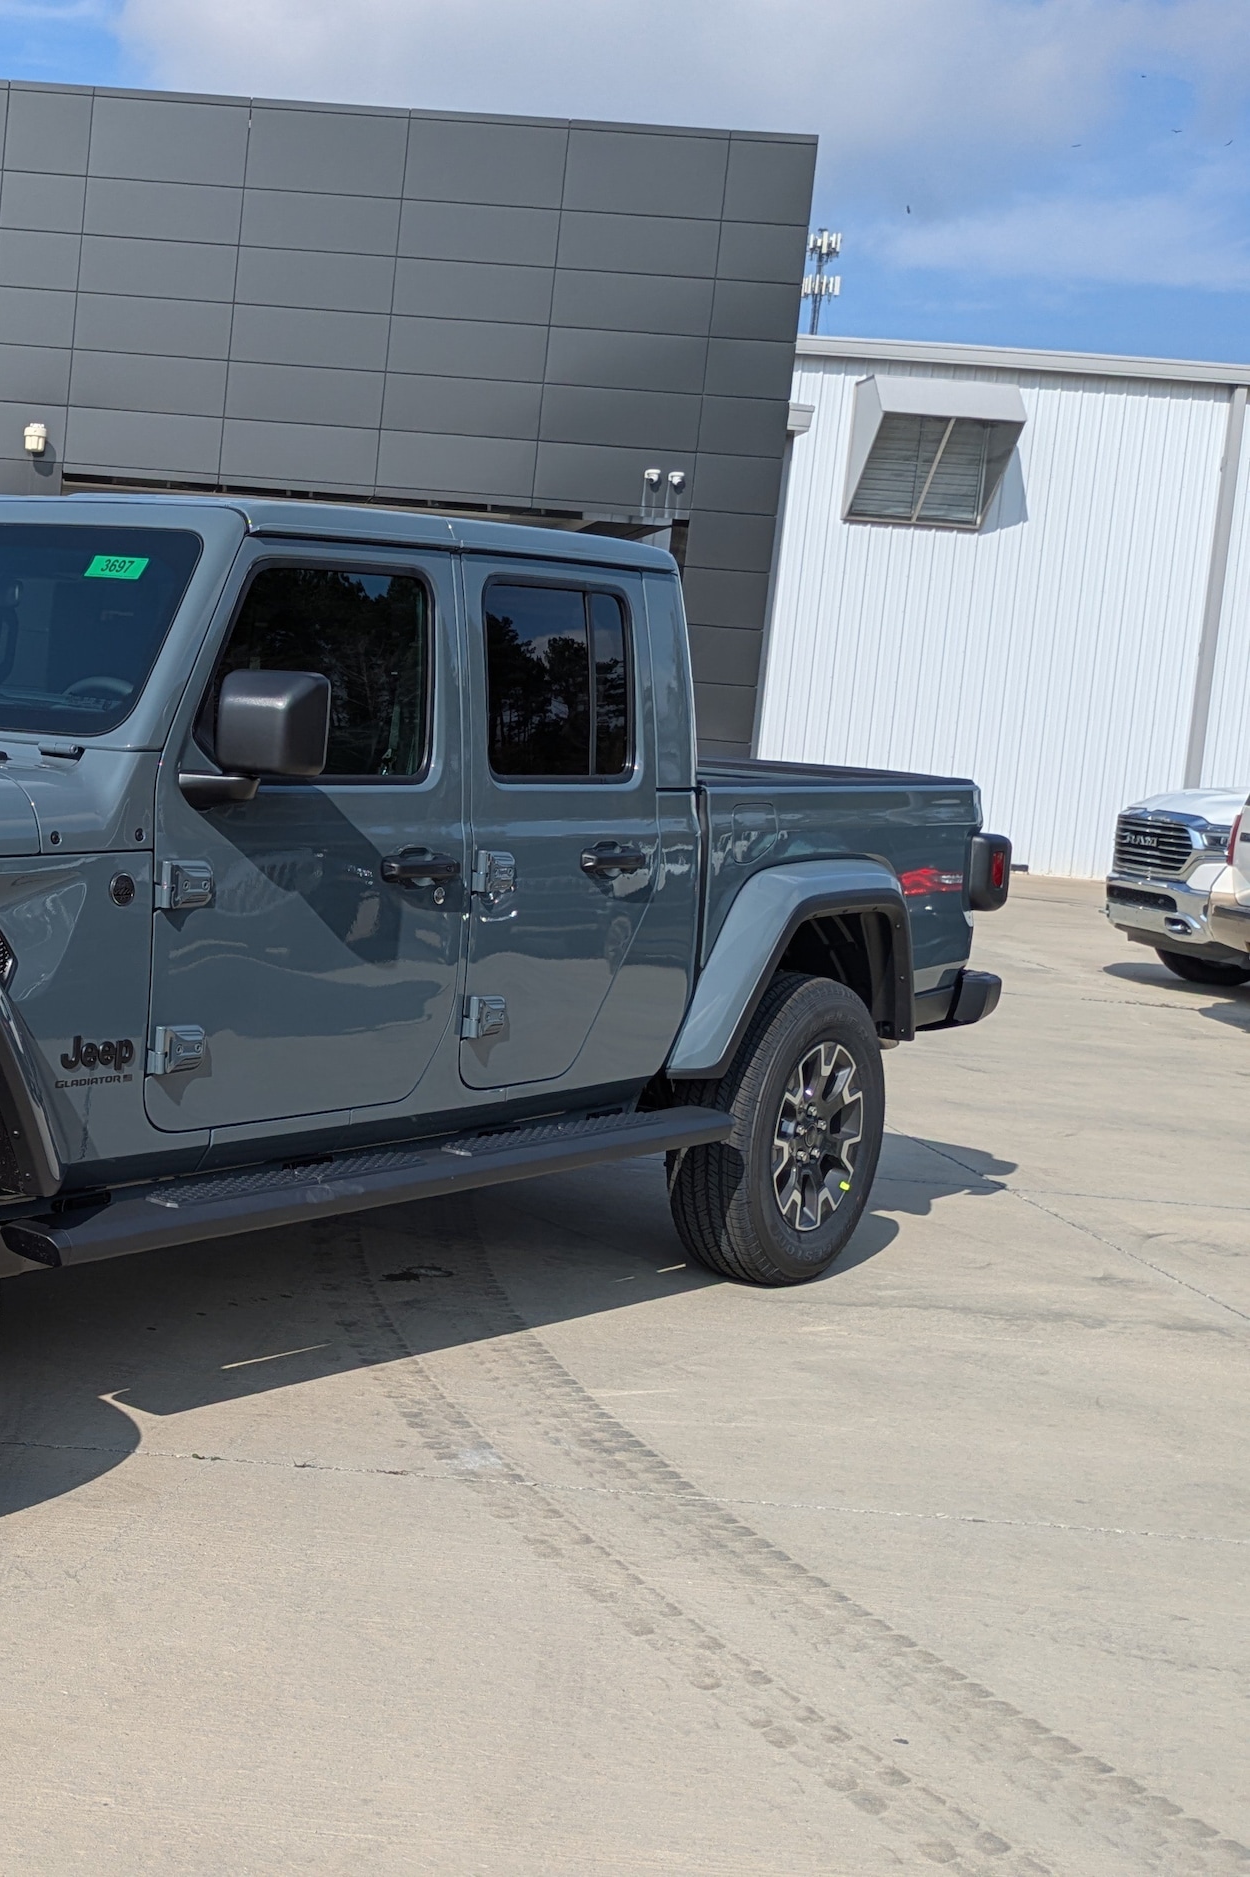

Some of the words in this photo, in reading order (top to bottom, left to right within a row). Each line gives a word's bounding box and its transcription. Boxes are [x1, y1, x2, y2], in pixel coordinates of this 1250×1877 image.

[100, 559, 135, 573] 3697
[1125, 833, 1159, 847] RAM
[60, 1035, 134, 1071] Jeep
[55, 1075, 121, 1088] GLADIATOR
